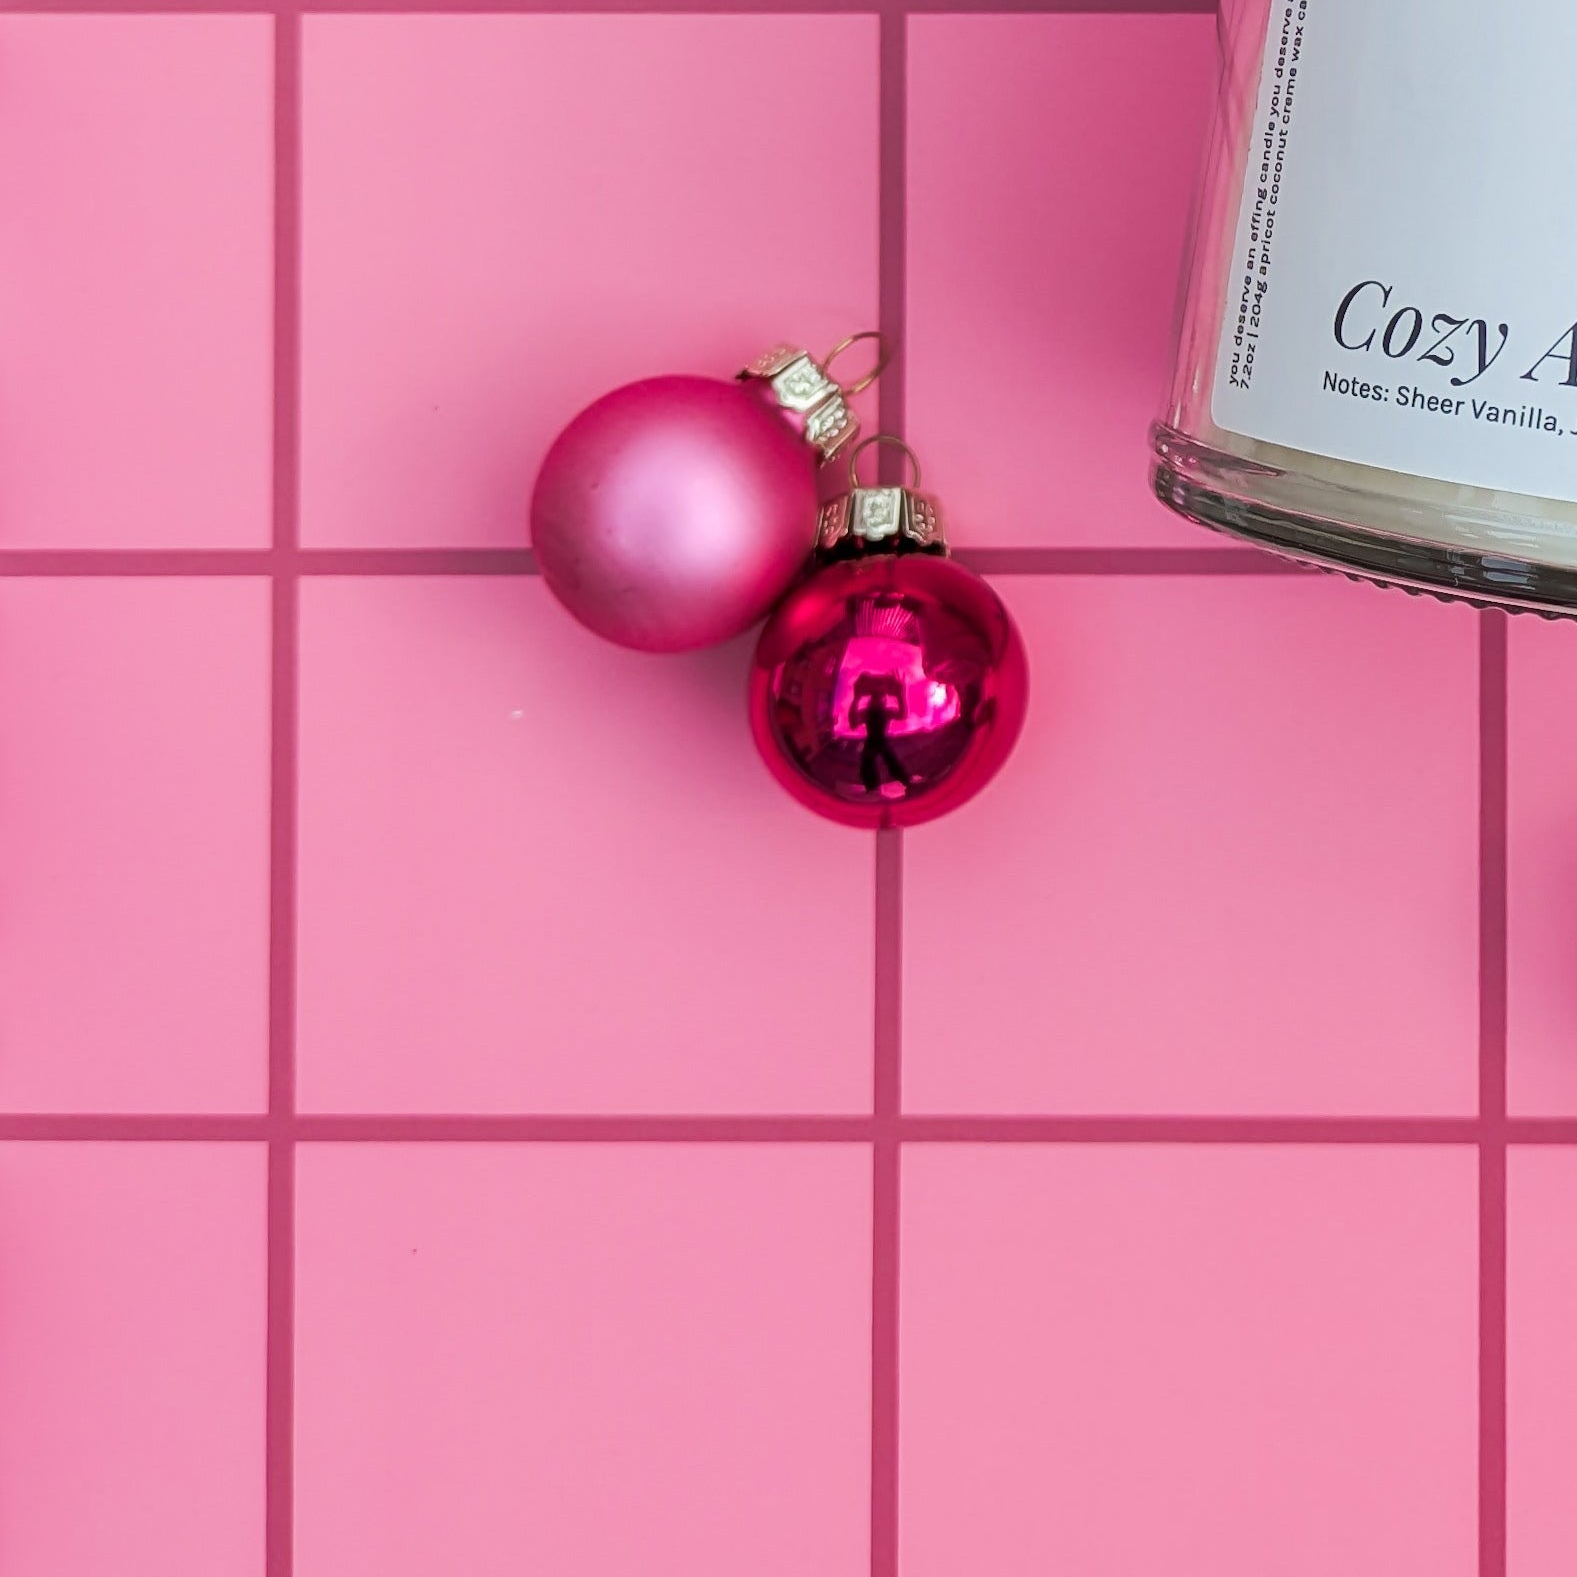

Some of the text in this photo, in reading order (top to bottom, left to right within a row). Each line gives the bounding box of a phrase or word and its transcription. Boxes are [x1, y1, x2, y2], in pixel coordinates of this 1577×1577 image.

[1275, 8, 1293, 78] deserve
[1270, 85, 1281, 118] you
[1260, 122, 1275, 183] candle
[1240, 343, 1256, 389] 7.2oz
[1250, 281, 1268, 328] 204g
[1259, 211, 1276, 275] apricot
[1270, 129, 1288, 205] coconut
[1282, 67, 1297, 124] creme
[1291, 25, 1304, 62] wax
[1250, 187, 1268, 242] effing
[1247, 248, 1256, 270] an
[1234, 275, 1252, 346] deserve
[1333, 279, 1509, 387] Cozy
[1229, 353, 1240, 387] you
[1322, 370, 1391, 404] Notes:
[1395, 386, 1465, 418] Sheer
[1471, 400, 1565, 438] Vanilla,
